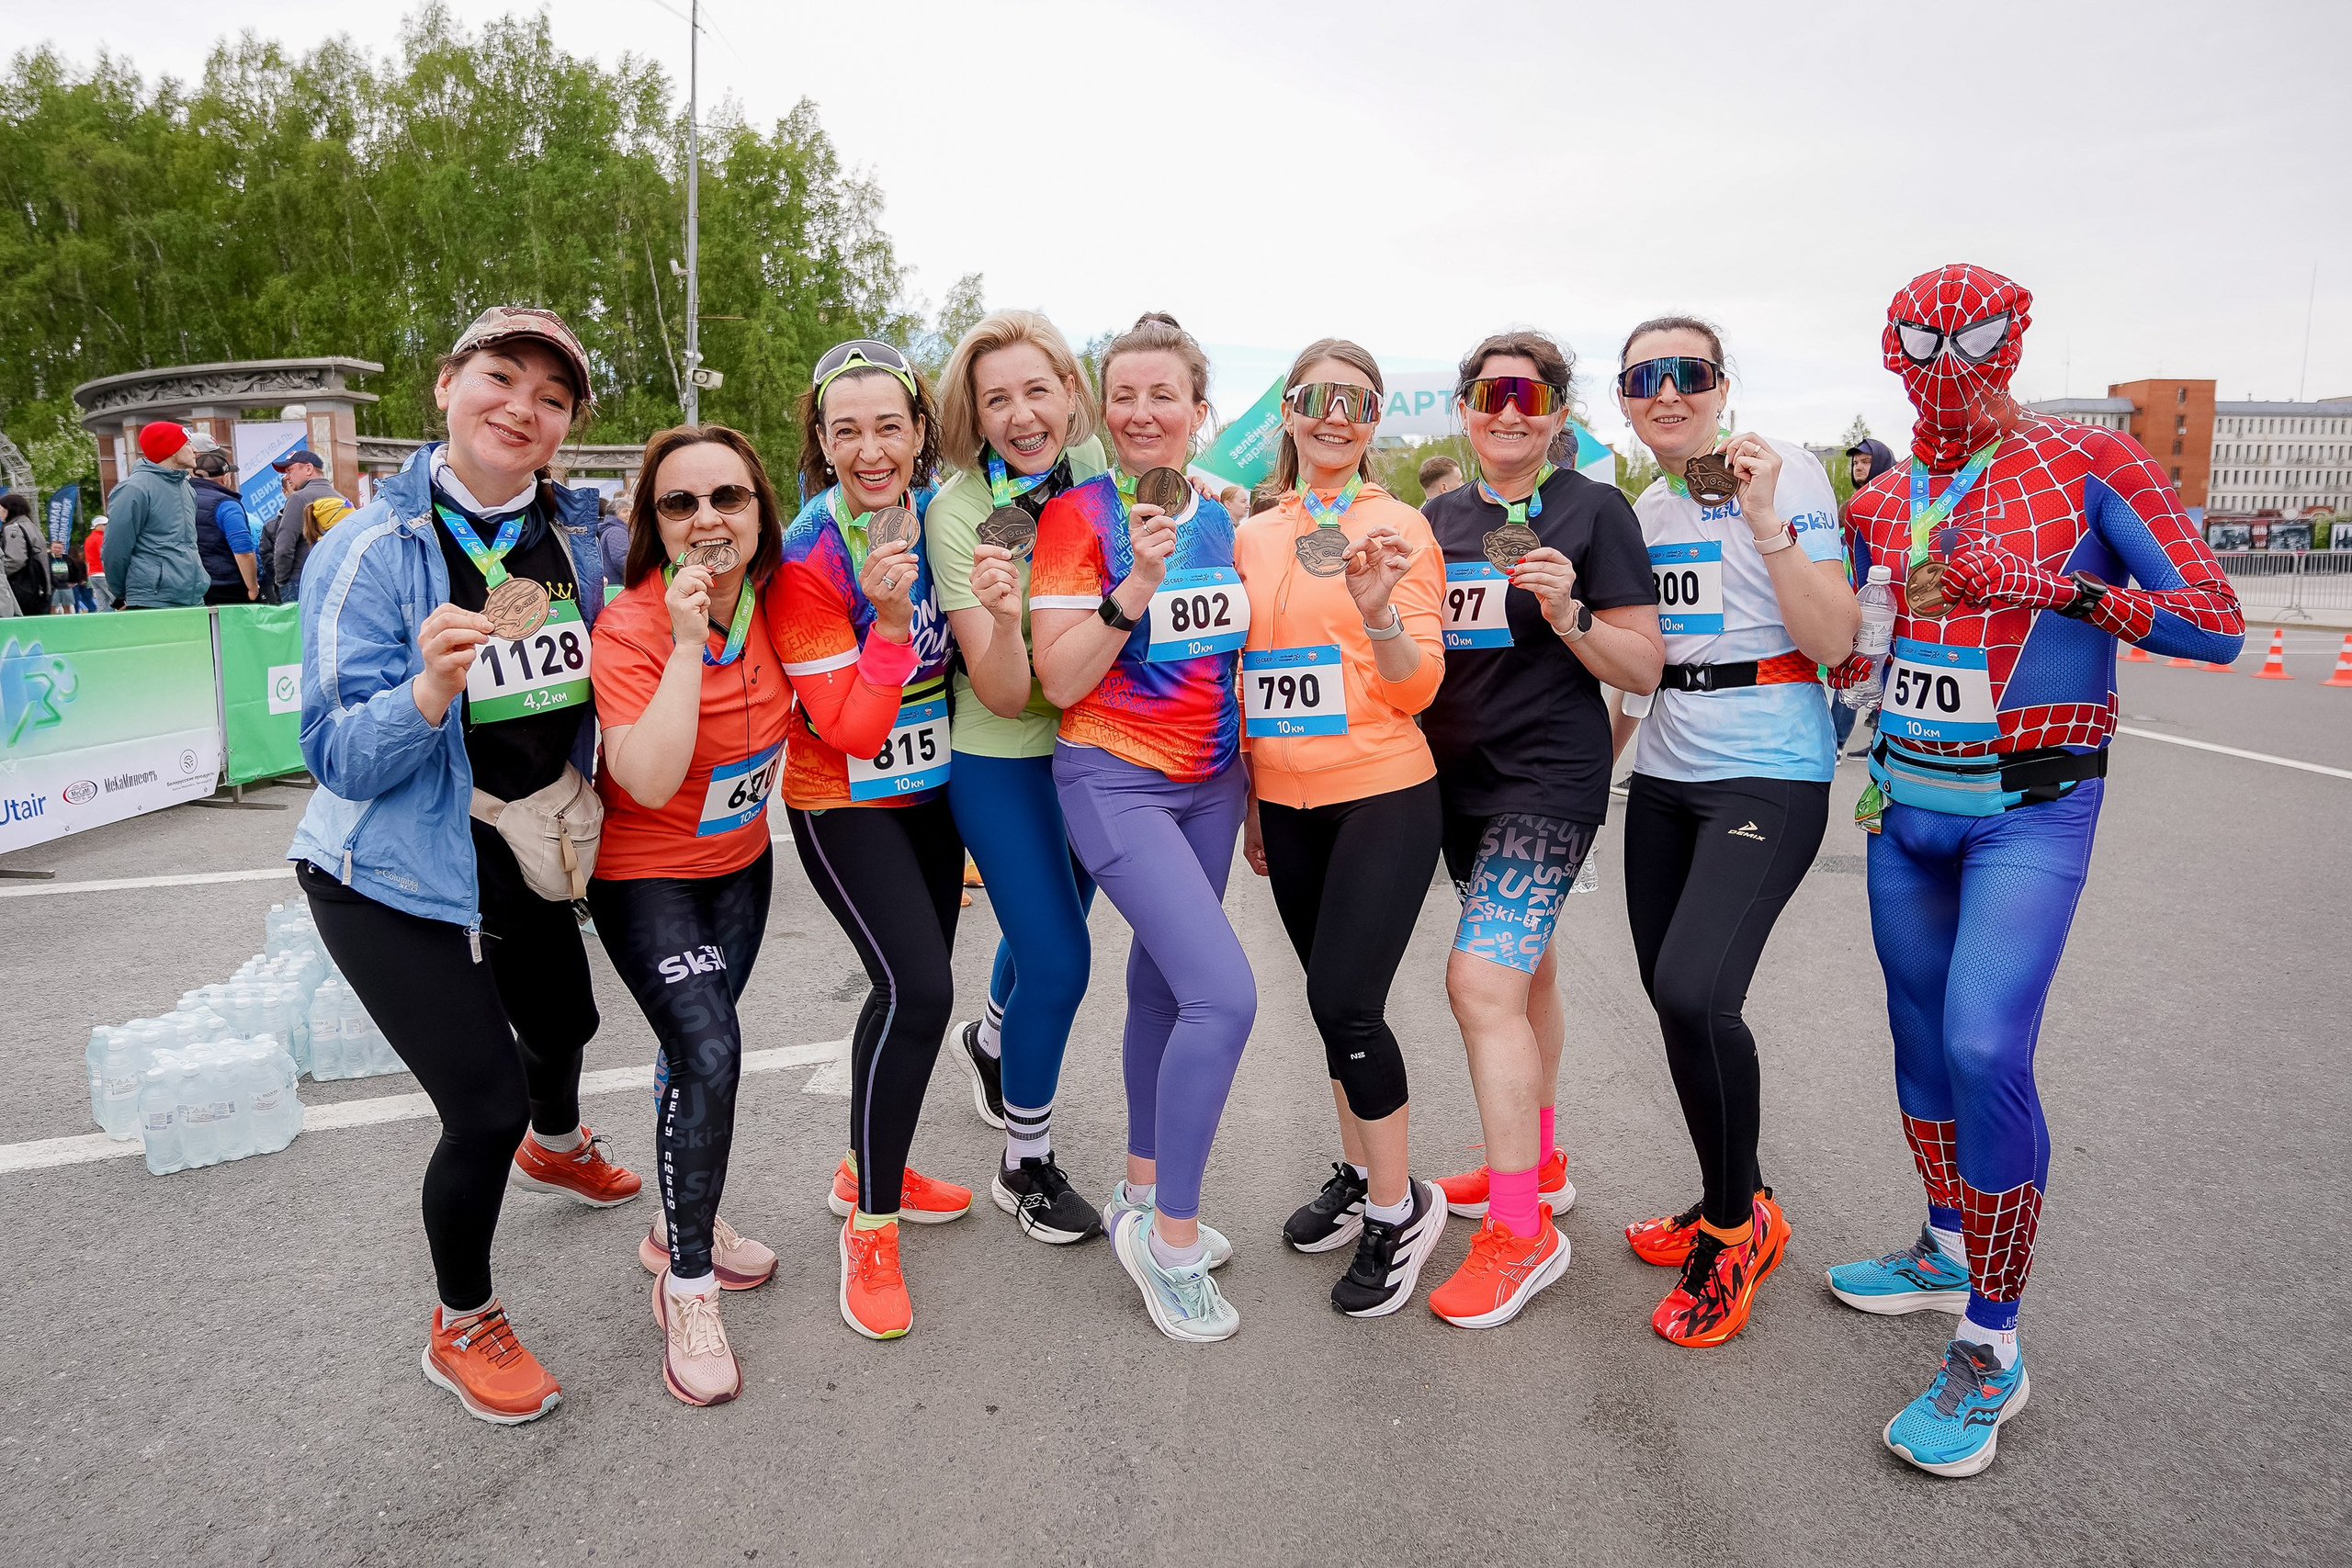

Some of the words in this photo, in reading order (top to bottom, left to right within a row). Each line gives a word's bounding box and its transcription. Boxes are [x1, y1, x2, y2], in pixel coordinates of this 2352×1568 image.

[1384, 389, 1454, 417] АРТ
[243, 432, 294, 472] ФЕСТИВАЛЬ
[1228, 412, 1278, 460] зелёный
[1170, 592, 1231, 632] 802
[1441, 587, 1487, 622] 97
[480, 630, 584, 687] 1128
[1258, 673, 1320, 710] 790
[1894, 667, 1961, 714] 570
[873, 727, 936, 771] 815
[728, 758, 777, 809] 670
[1727, 829, 1766, 841] DEMIX
[382, 869, 419, 888] Columbia
[664, 1088, 680, 1137] БЕГУ
[669, 1221, 681, 1261] ЖИВУ
